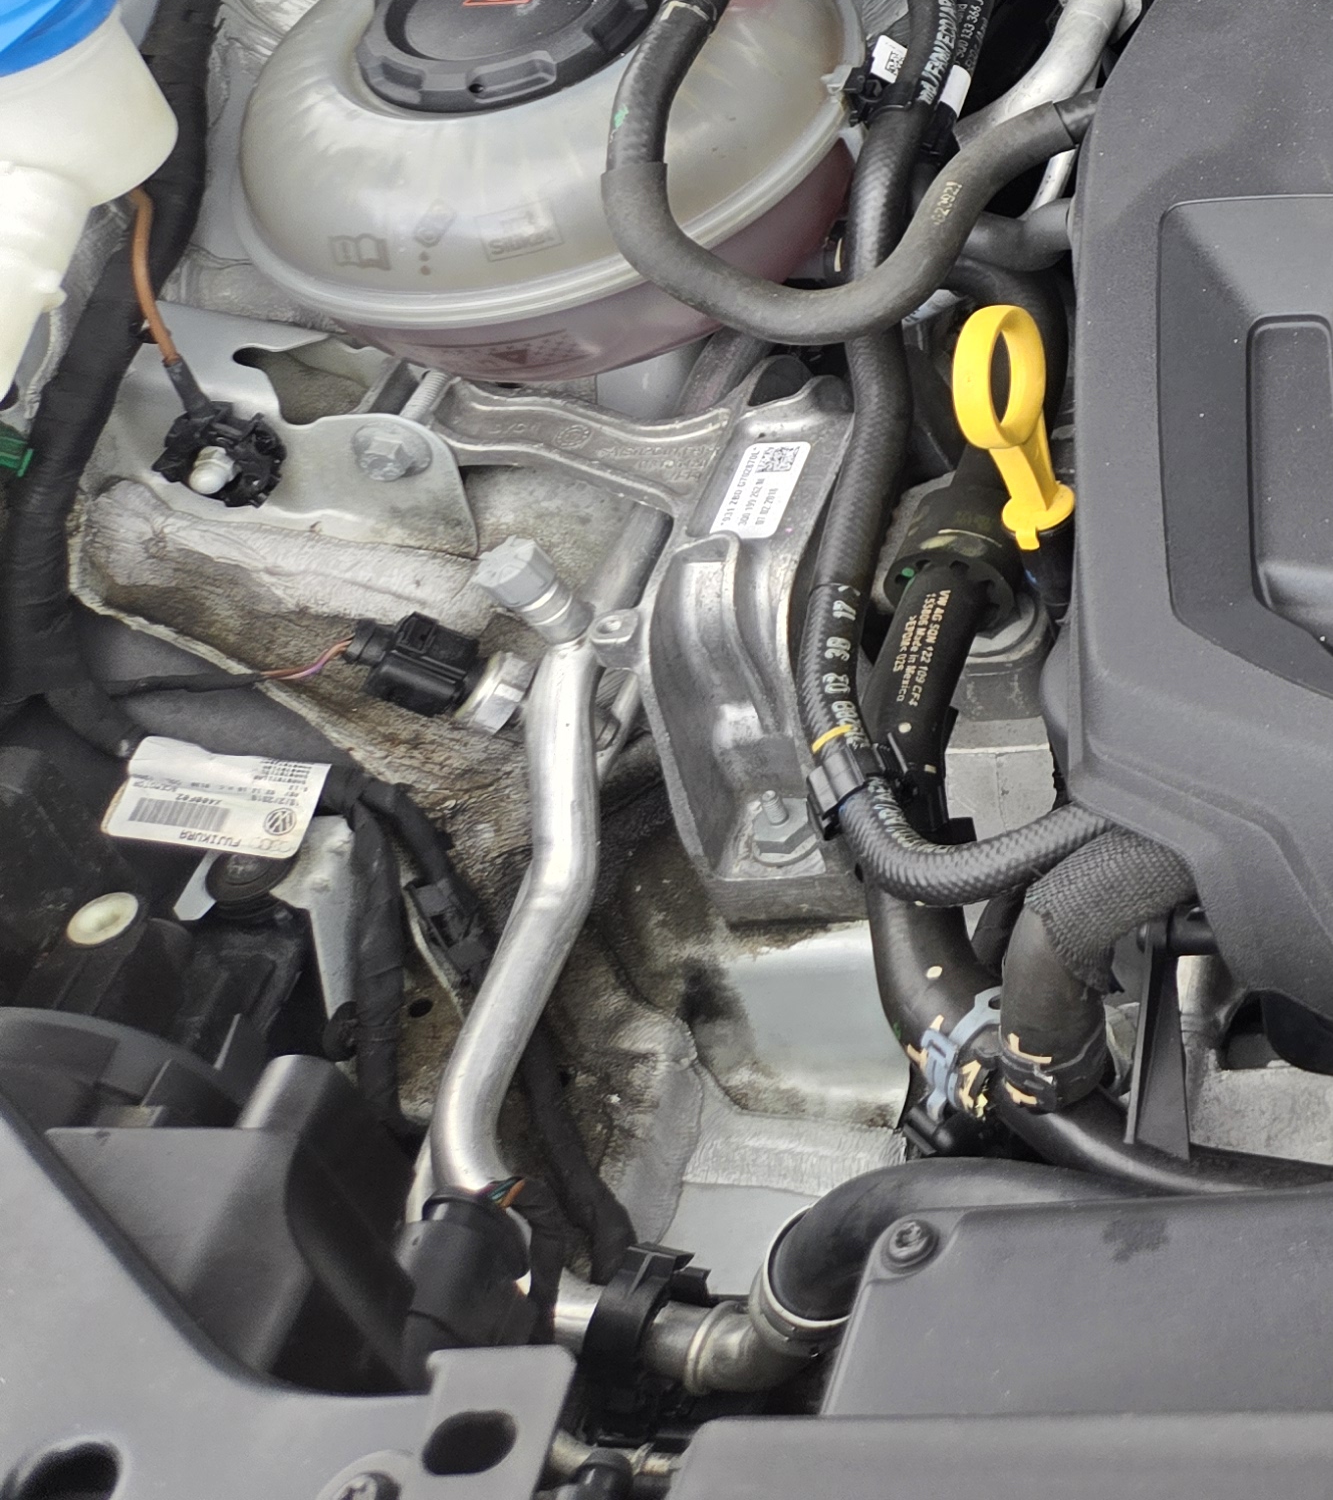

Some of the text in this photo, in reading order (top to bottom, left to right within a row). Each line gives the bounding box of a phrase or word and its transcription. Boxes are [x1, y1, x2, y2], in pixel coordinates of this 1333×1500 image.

[966, 4, 981, 23] 366
[960, 22, 975, 40] 133
[935, 588, 951, 607] VW
[931, 607, 944, 622] AG
[909, 626, 925, 653] Made
[907, 653, 918, 663] in
[920, 645, 934, 663] 122
[896, 663, 915, 703] Mexico
[915, 665, 929, 684] 109
[178, 829, 241, 847] FUJIKURA
